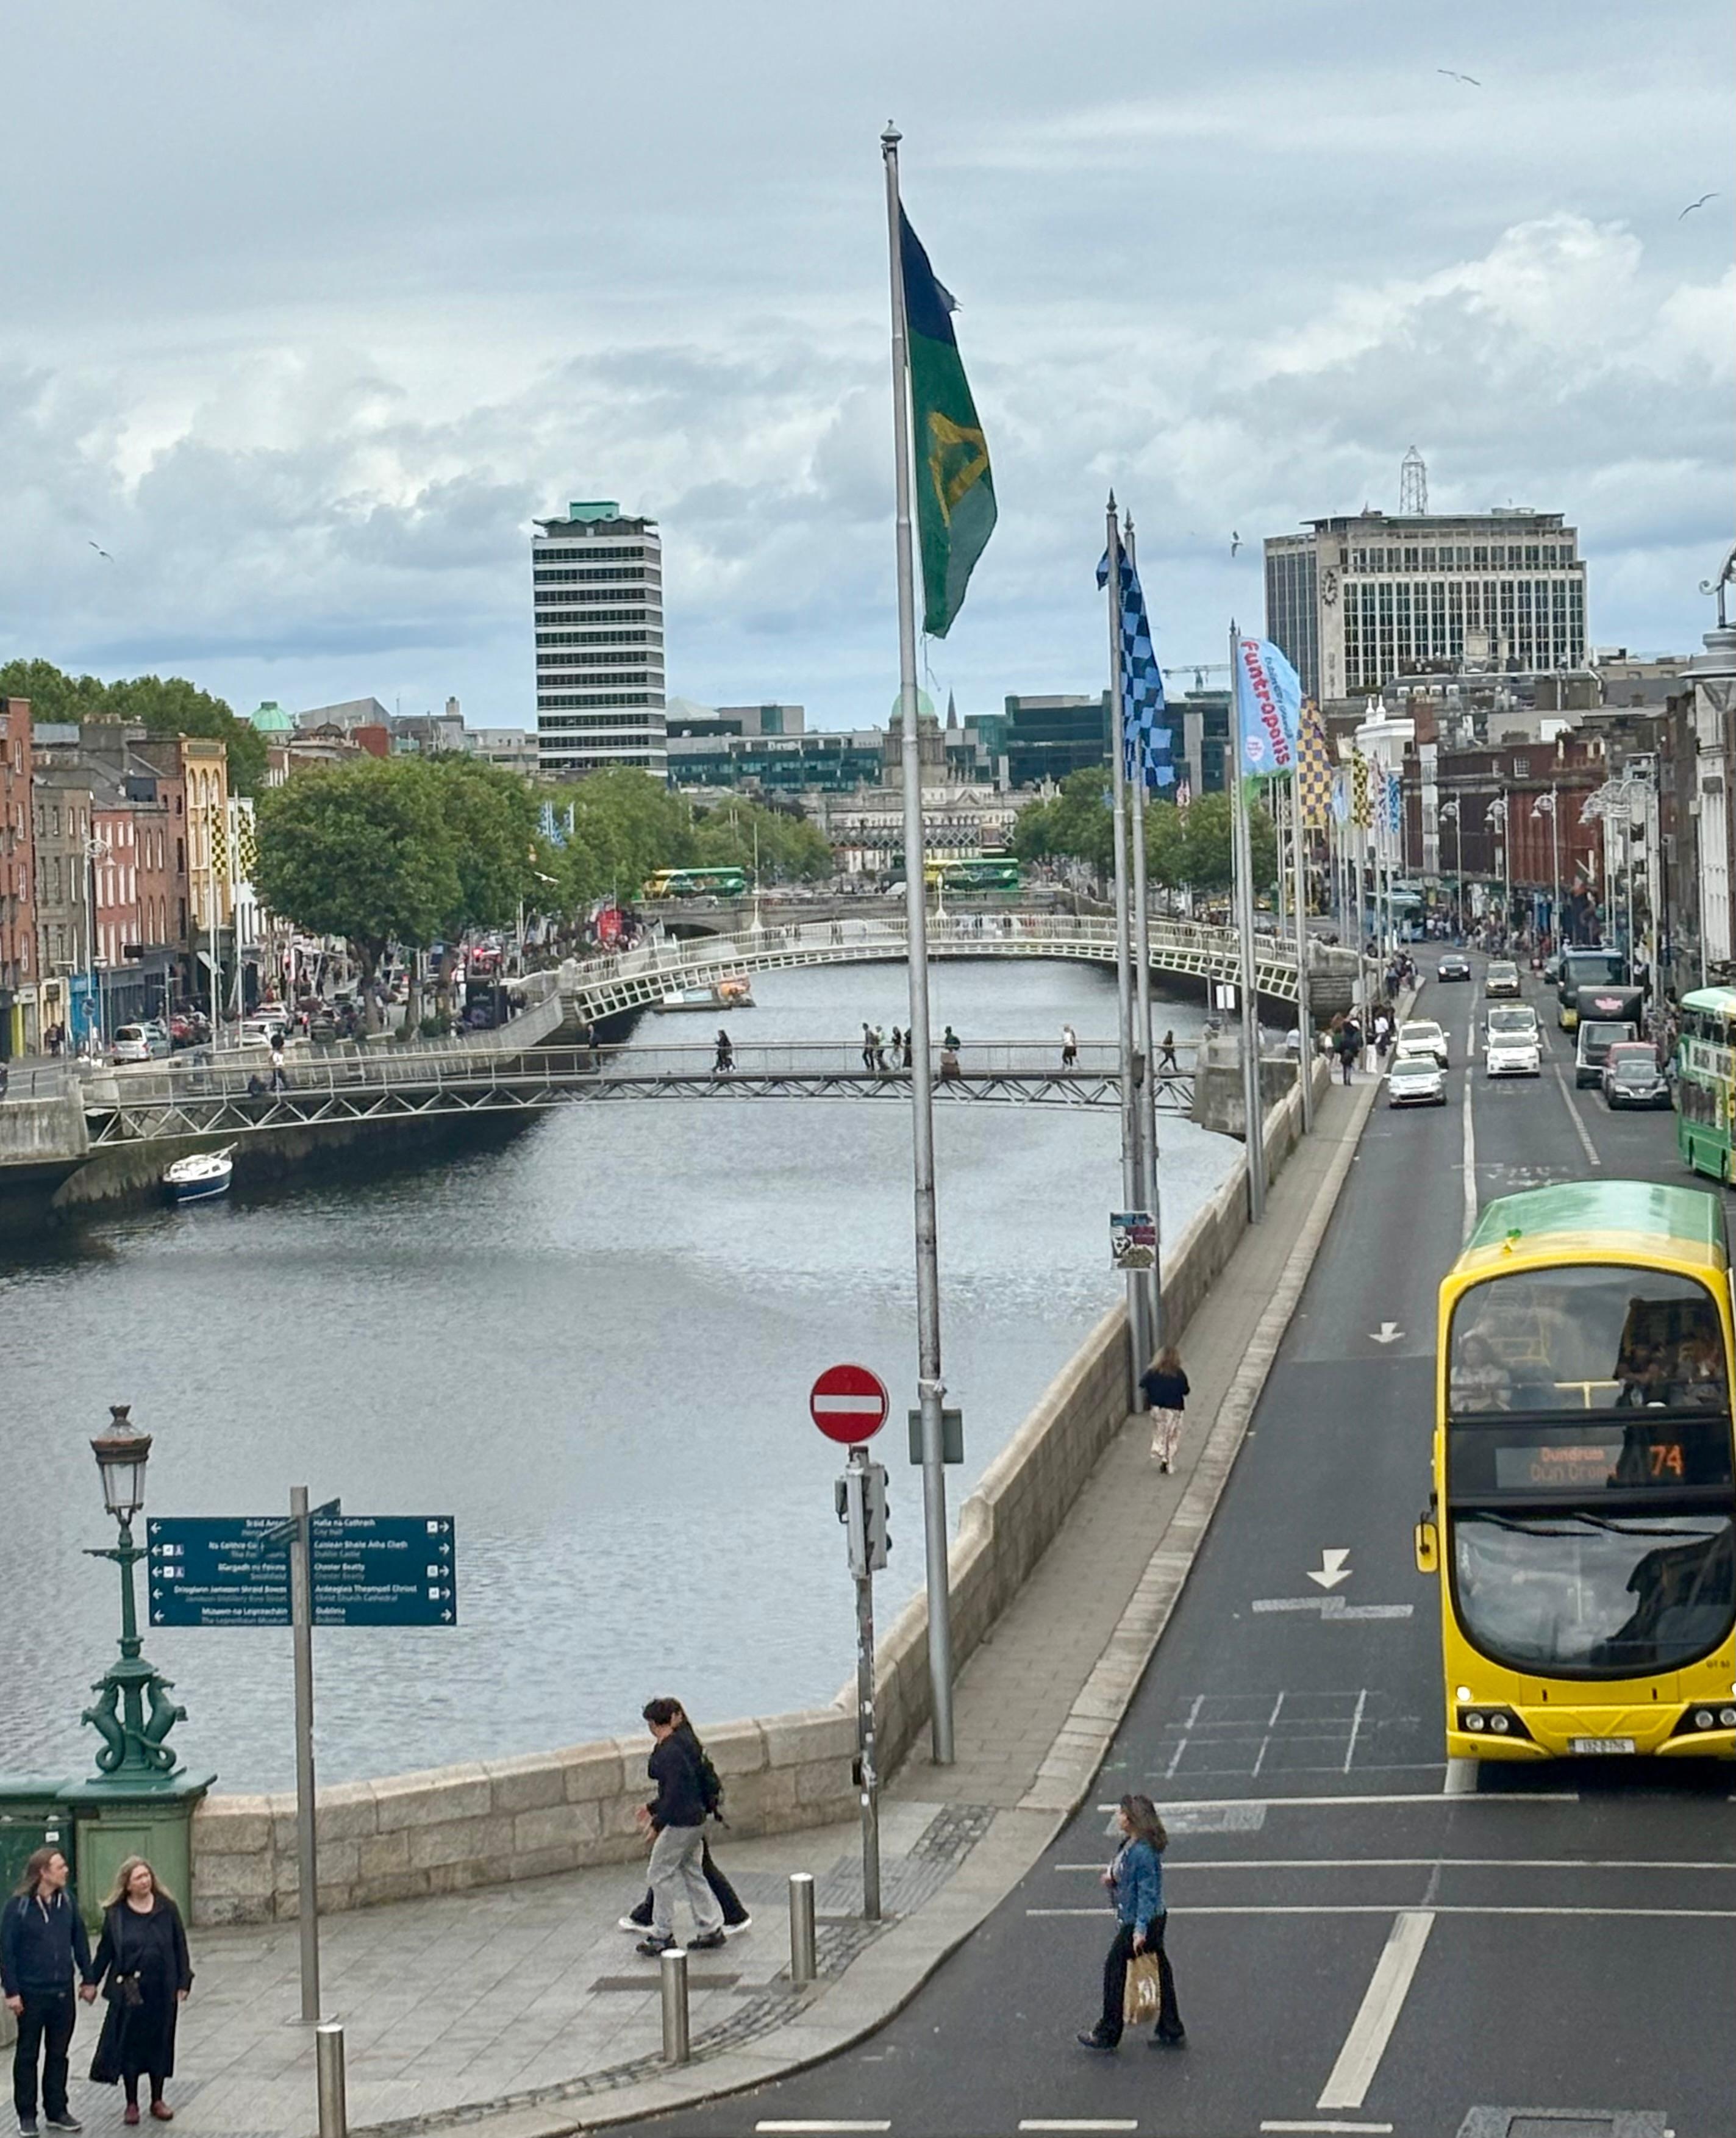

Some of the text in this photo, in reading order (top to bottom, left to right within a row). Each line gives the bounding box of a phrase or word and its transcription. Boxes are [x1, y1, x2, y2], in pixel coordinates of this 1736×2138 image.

[1240, 640, 1290, 765] Funtropolis
[1541, 1447, 1604, 1462] Dundrum
[1649, 1445, 1682, 1477] 74
